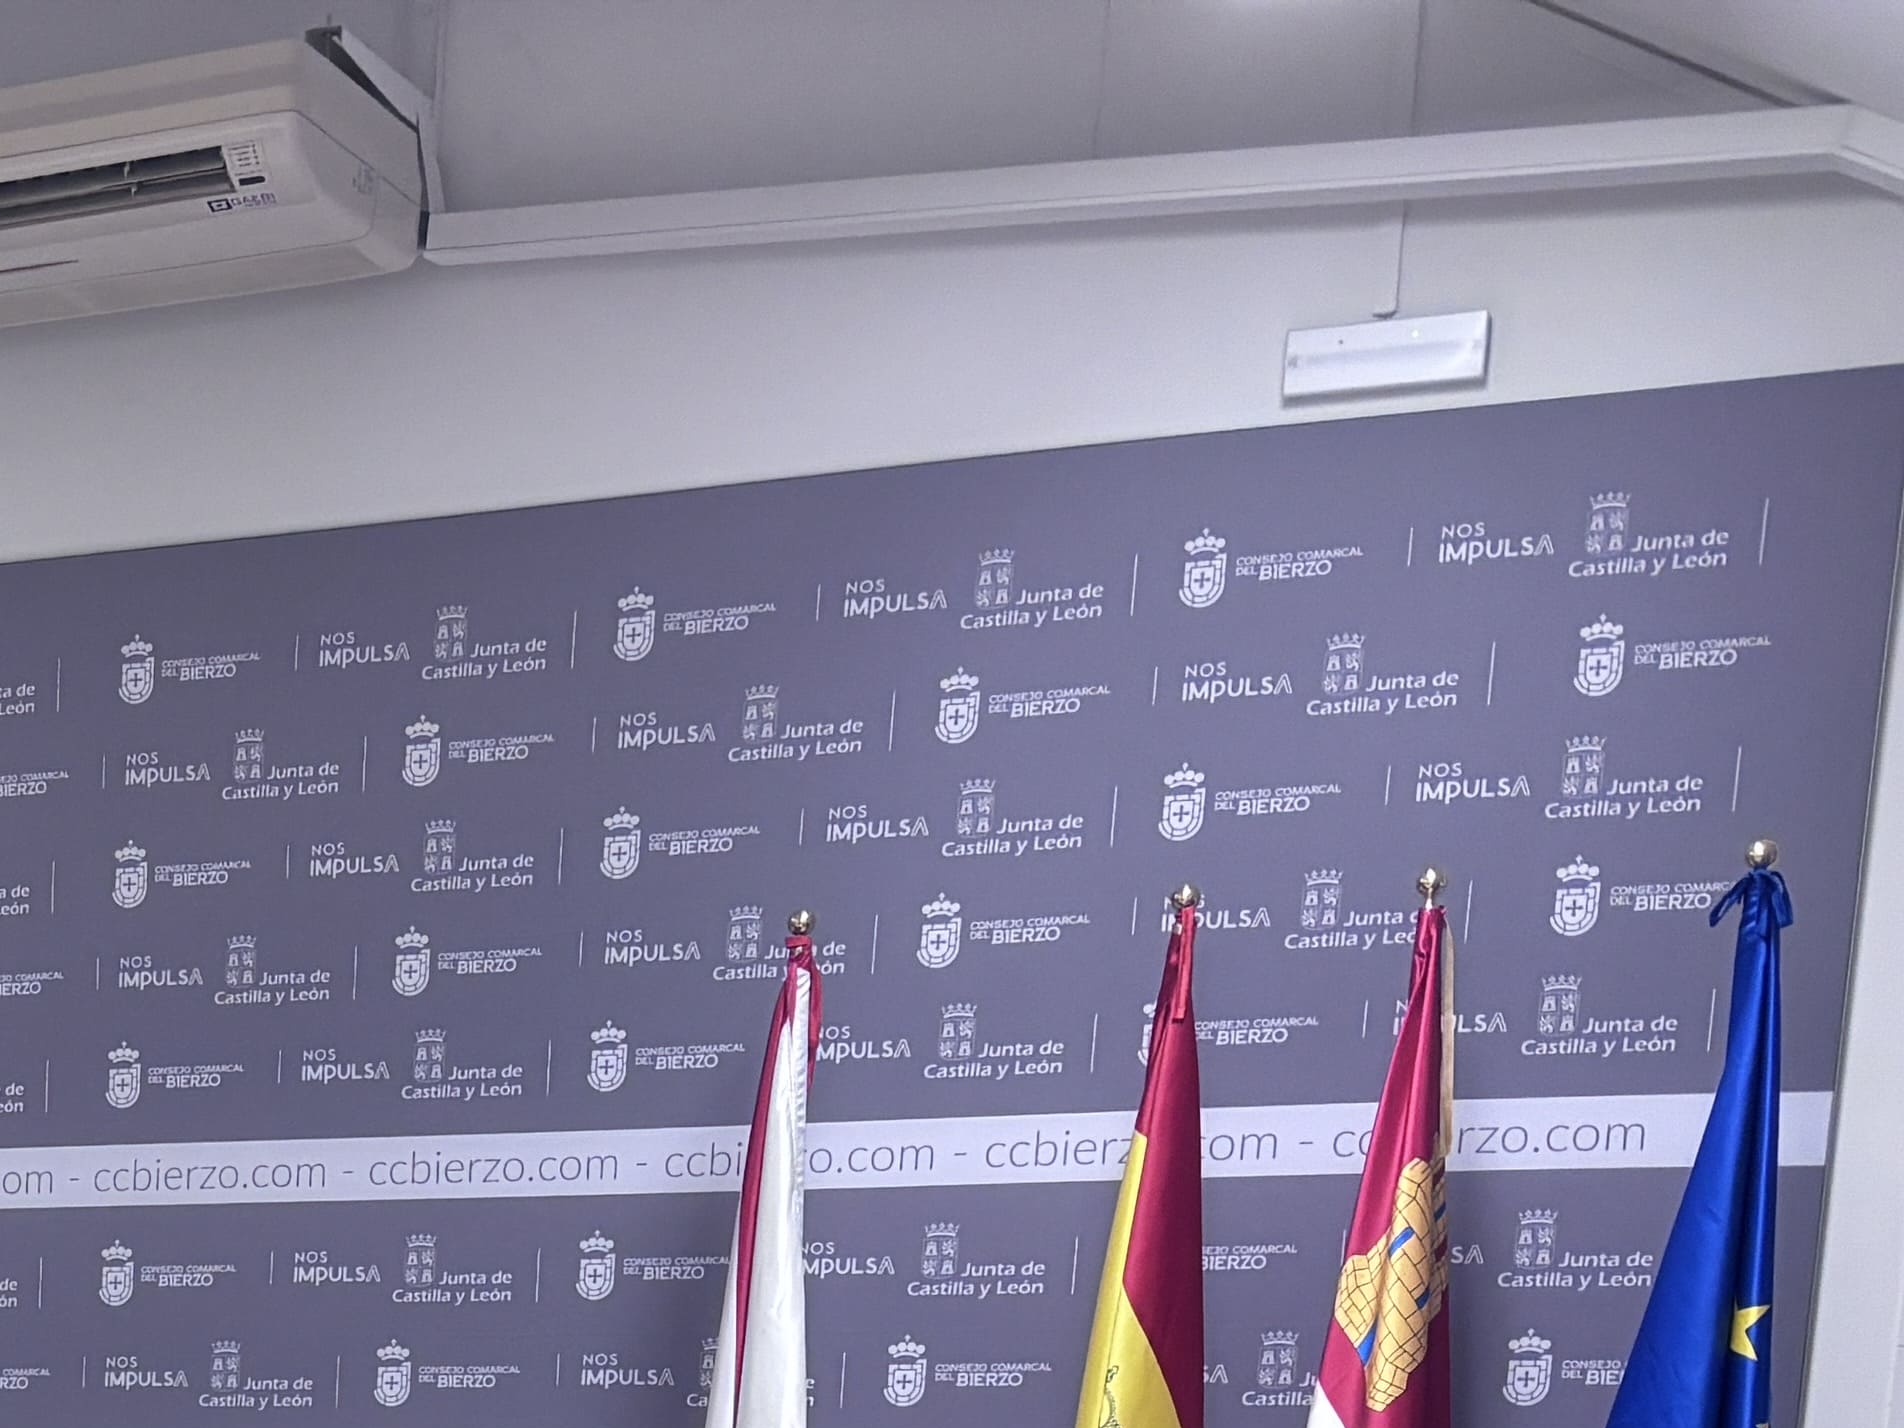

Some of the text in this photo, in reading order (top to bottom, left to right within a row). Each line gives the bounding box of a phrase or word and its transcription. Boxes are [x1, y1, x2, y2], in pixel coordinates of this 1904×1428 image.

[1441, 521, 1485, 540] NOS
[1631, 528, 1729, 553] Junta de
[1438, 534, 1555, 566] IMPULSA
[1258, 559, 1332, 581] BIERZO
[1568, 550, 1727, 578] Castilla y León
[1658, 648, 1738, 670] BIERZO
[1184, 661, 1227, 679] NOS
[15, 683, 36, 697] de
[1181, 673, 1293, 704] IMPULSA
[1365, 670, 1459, 692] Junta de
[1306, 690, 1457, 716] Castilla y León
[126, 751, 159, 767] NOS
[124, 762, 211, 788] IMPULSA
[266, 761, 340, 780] Junta de
[1418, 762, 1462, 780] NOS
[221, 779, 339, 801] Castilla y León
[1415, 775, 1530, 805] IMPULSA
[1606, 775, 1704, 796] Junta de
[1236, 795, 1311, 816] BIERZO
[1544, 795, 1701, 820] Castilla y León
[456, 957, 517, 975] BIERZO
[4, 1082, 25, 1096] de
[165, 1073, 221, 1089] BIERZO
[94, 1158, 327, 1192] ccbierzo.com
[369, 1150, 619, 1186] ccbierzo.com
[665, 1141, 934, 1178] ccbio.com
[294, 1250, 328, 1264] NOS
[158, 1272, 214, 1287] BIERZO
[293, 1265, 381, 1287] IMPULSA
[438, 1270, 513, 1285] Junta de
[392, 1287, 512, 1306] Castilla y León
[955, 1372, 1024, 1387] BIERZO
